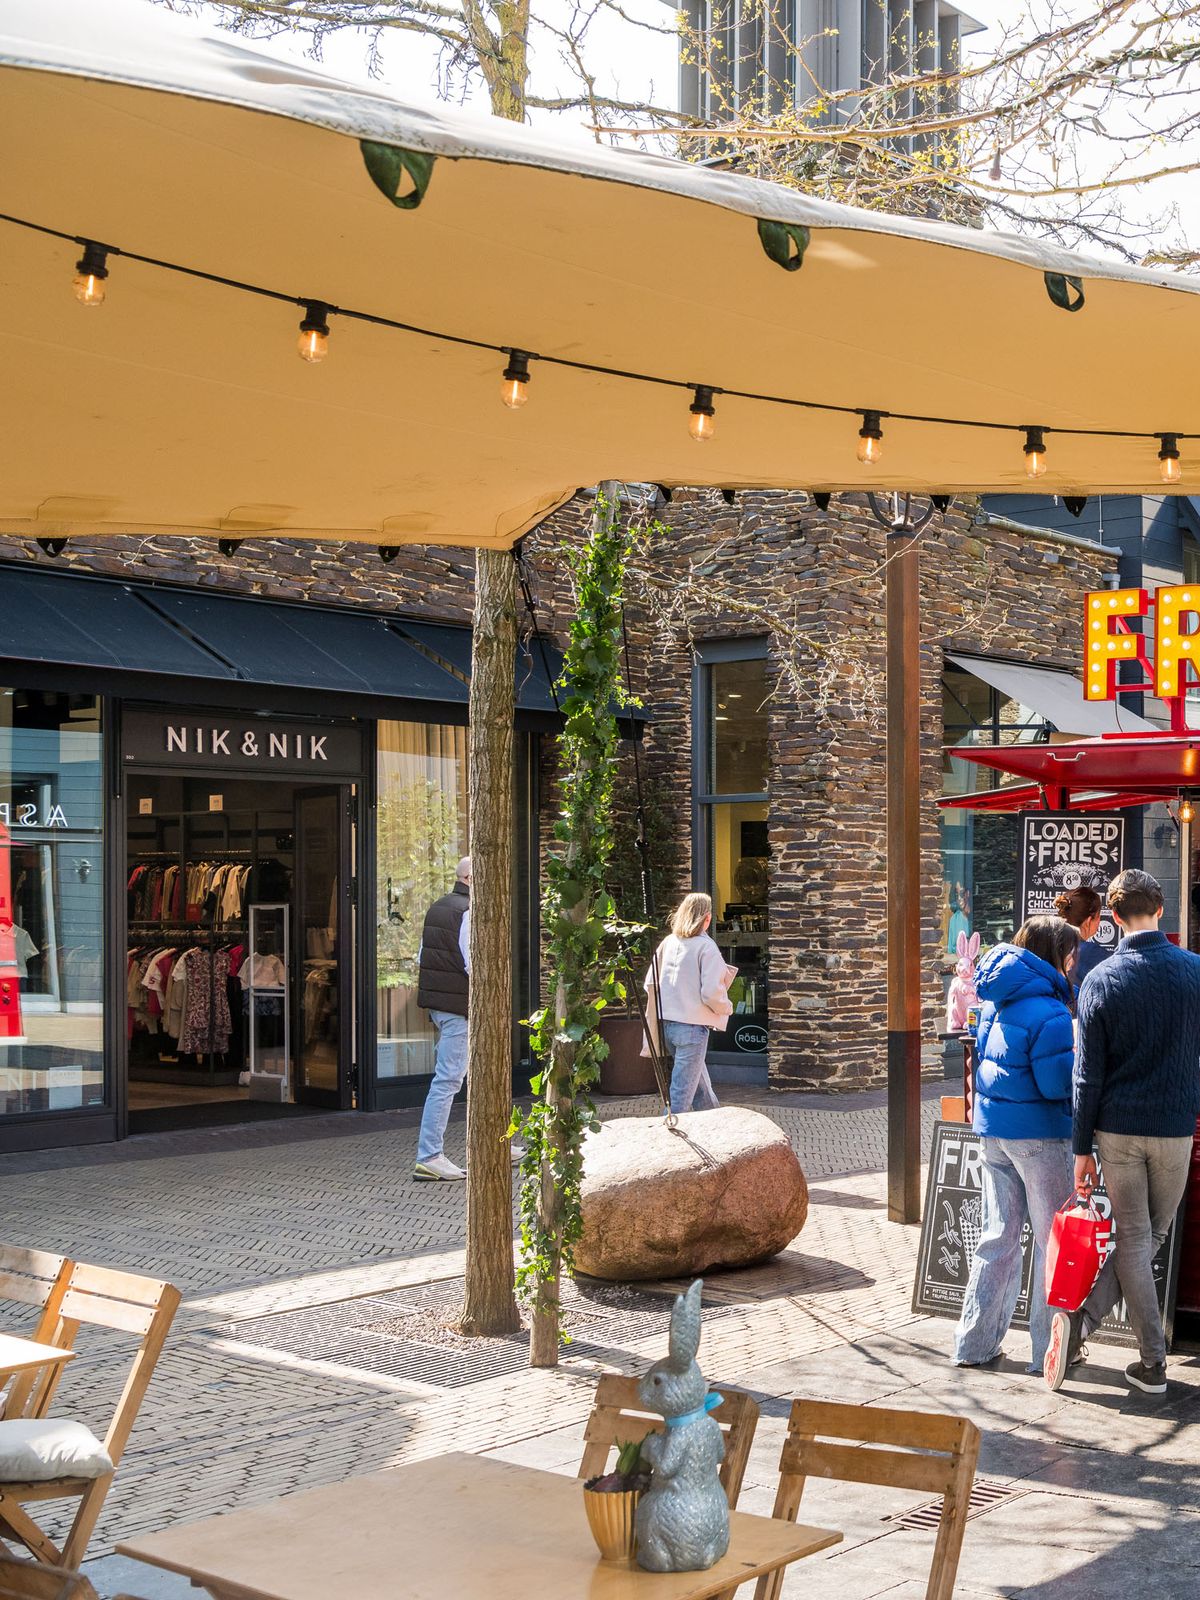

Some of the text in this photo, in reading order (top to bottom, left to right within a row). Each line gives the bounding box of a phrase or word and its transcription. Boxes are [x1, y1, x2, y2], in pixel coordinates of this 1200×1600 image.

[167, 726, 328, 760] NIK & NIK
[1029, 822, 1119, 841] LOADED
[1038, 841, 1108, 867] FRIES
[738, 1032, 767, 1043] RÖSLE
